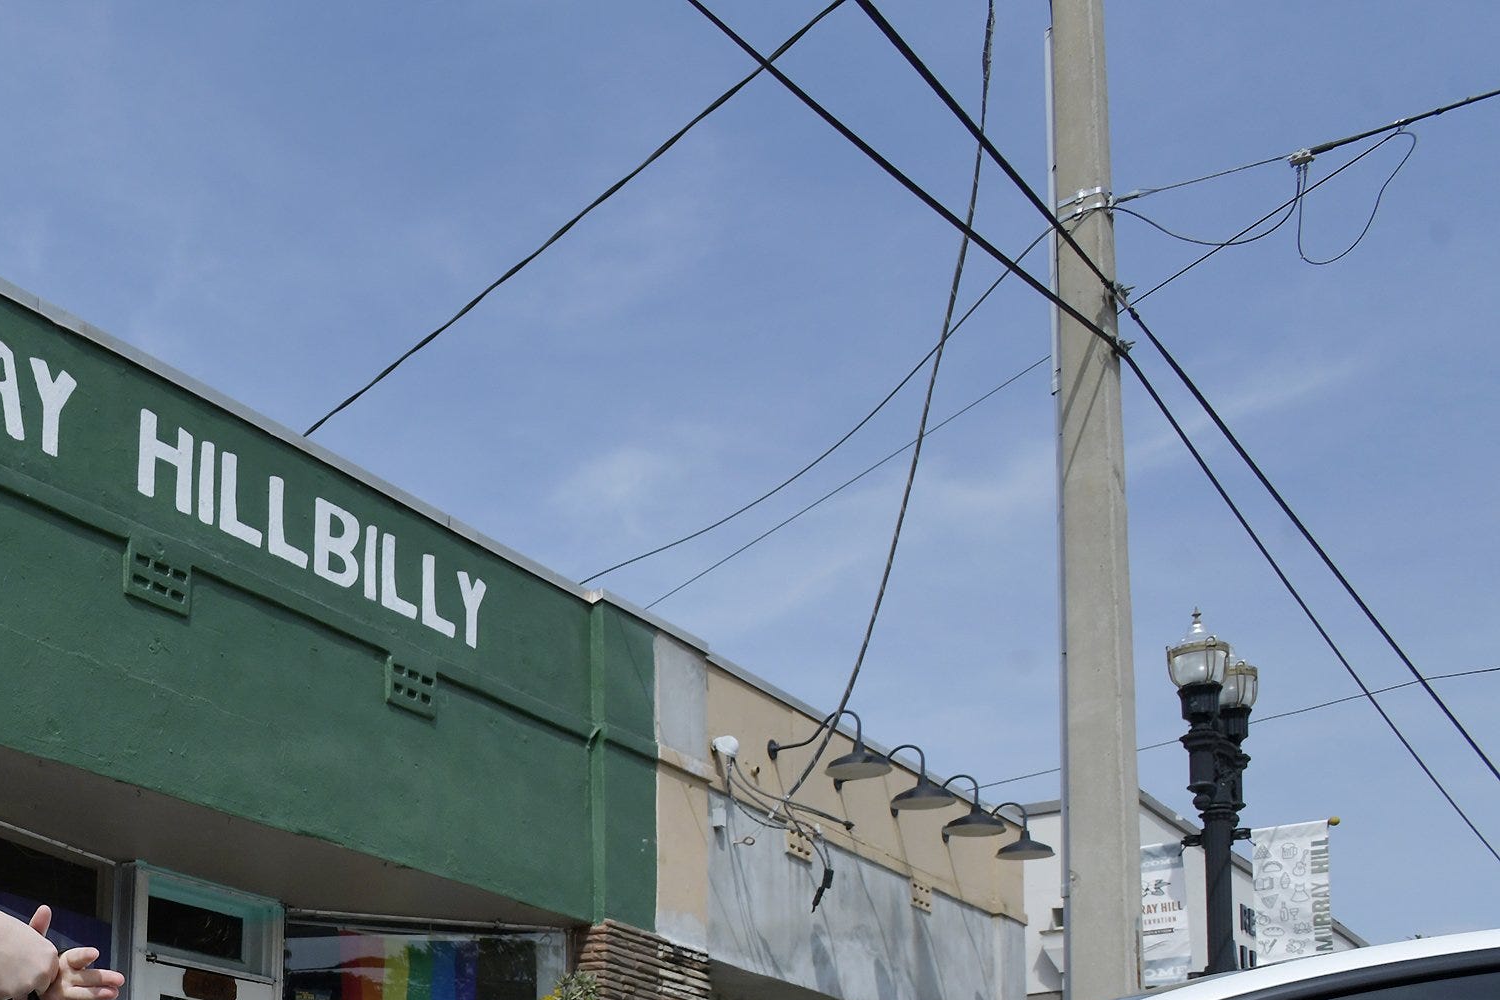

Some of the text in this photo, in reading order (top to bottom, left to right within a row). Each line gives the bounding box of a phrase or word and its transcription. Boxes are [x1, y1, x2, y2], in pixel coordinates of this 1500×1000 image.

[136, 408, 488, 650] HILLBILLY
[1142, 858, 1179, 867] COME
[1310, 837, 1334, 952] MURRAY HILL
[1140, 900, 1184, 914] RAY HILL
